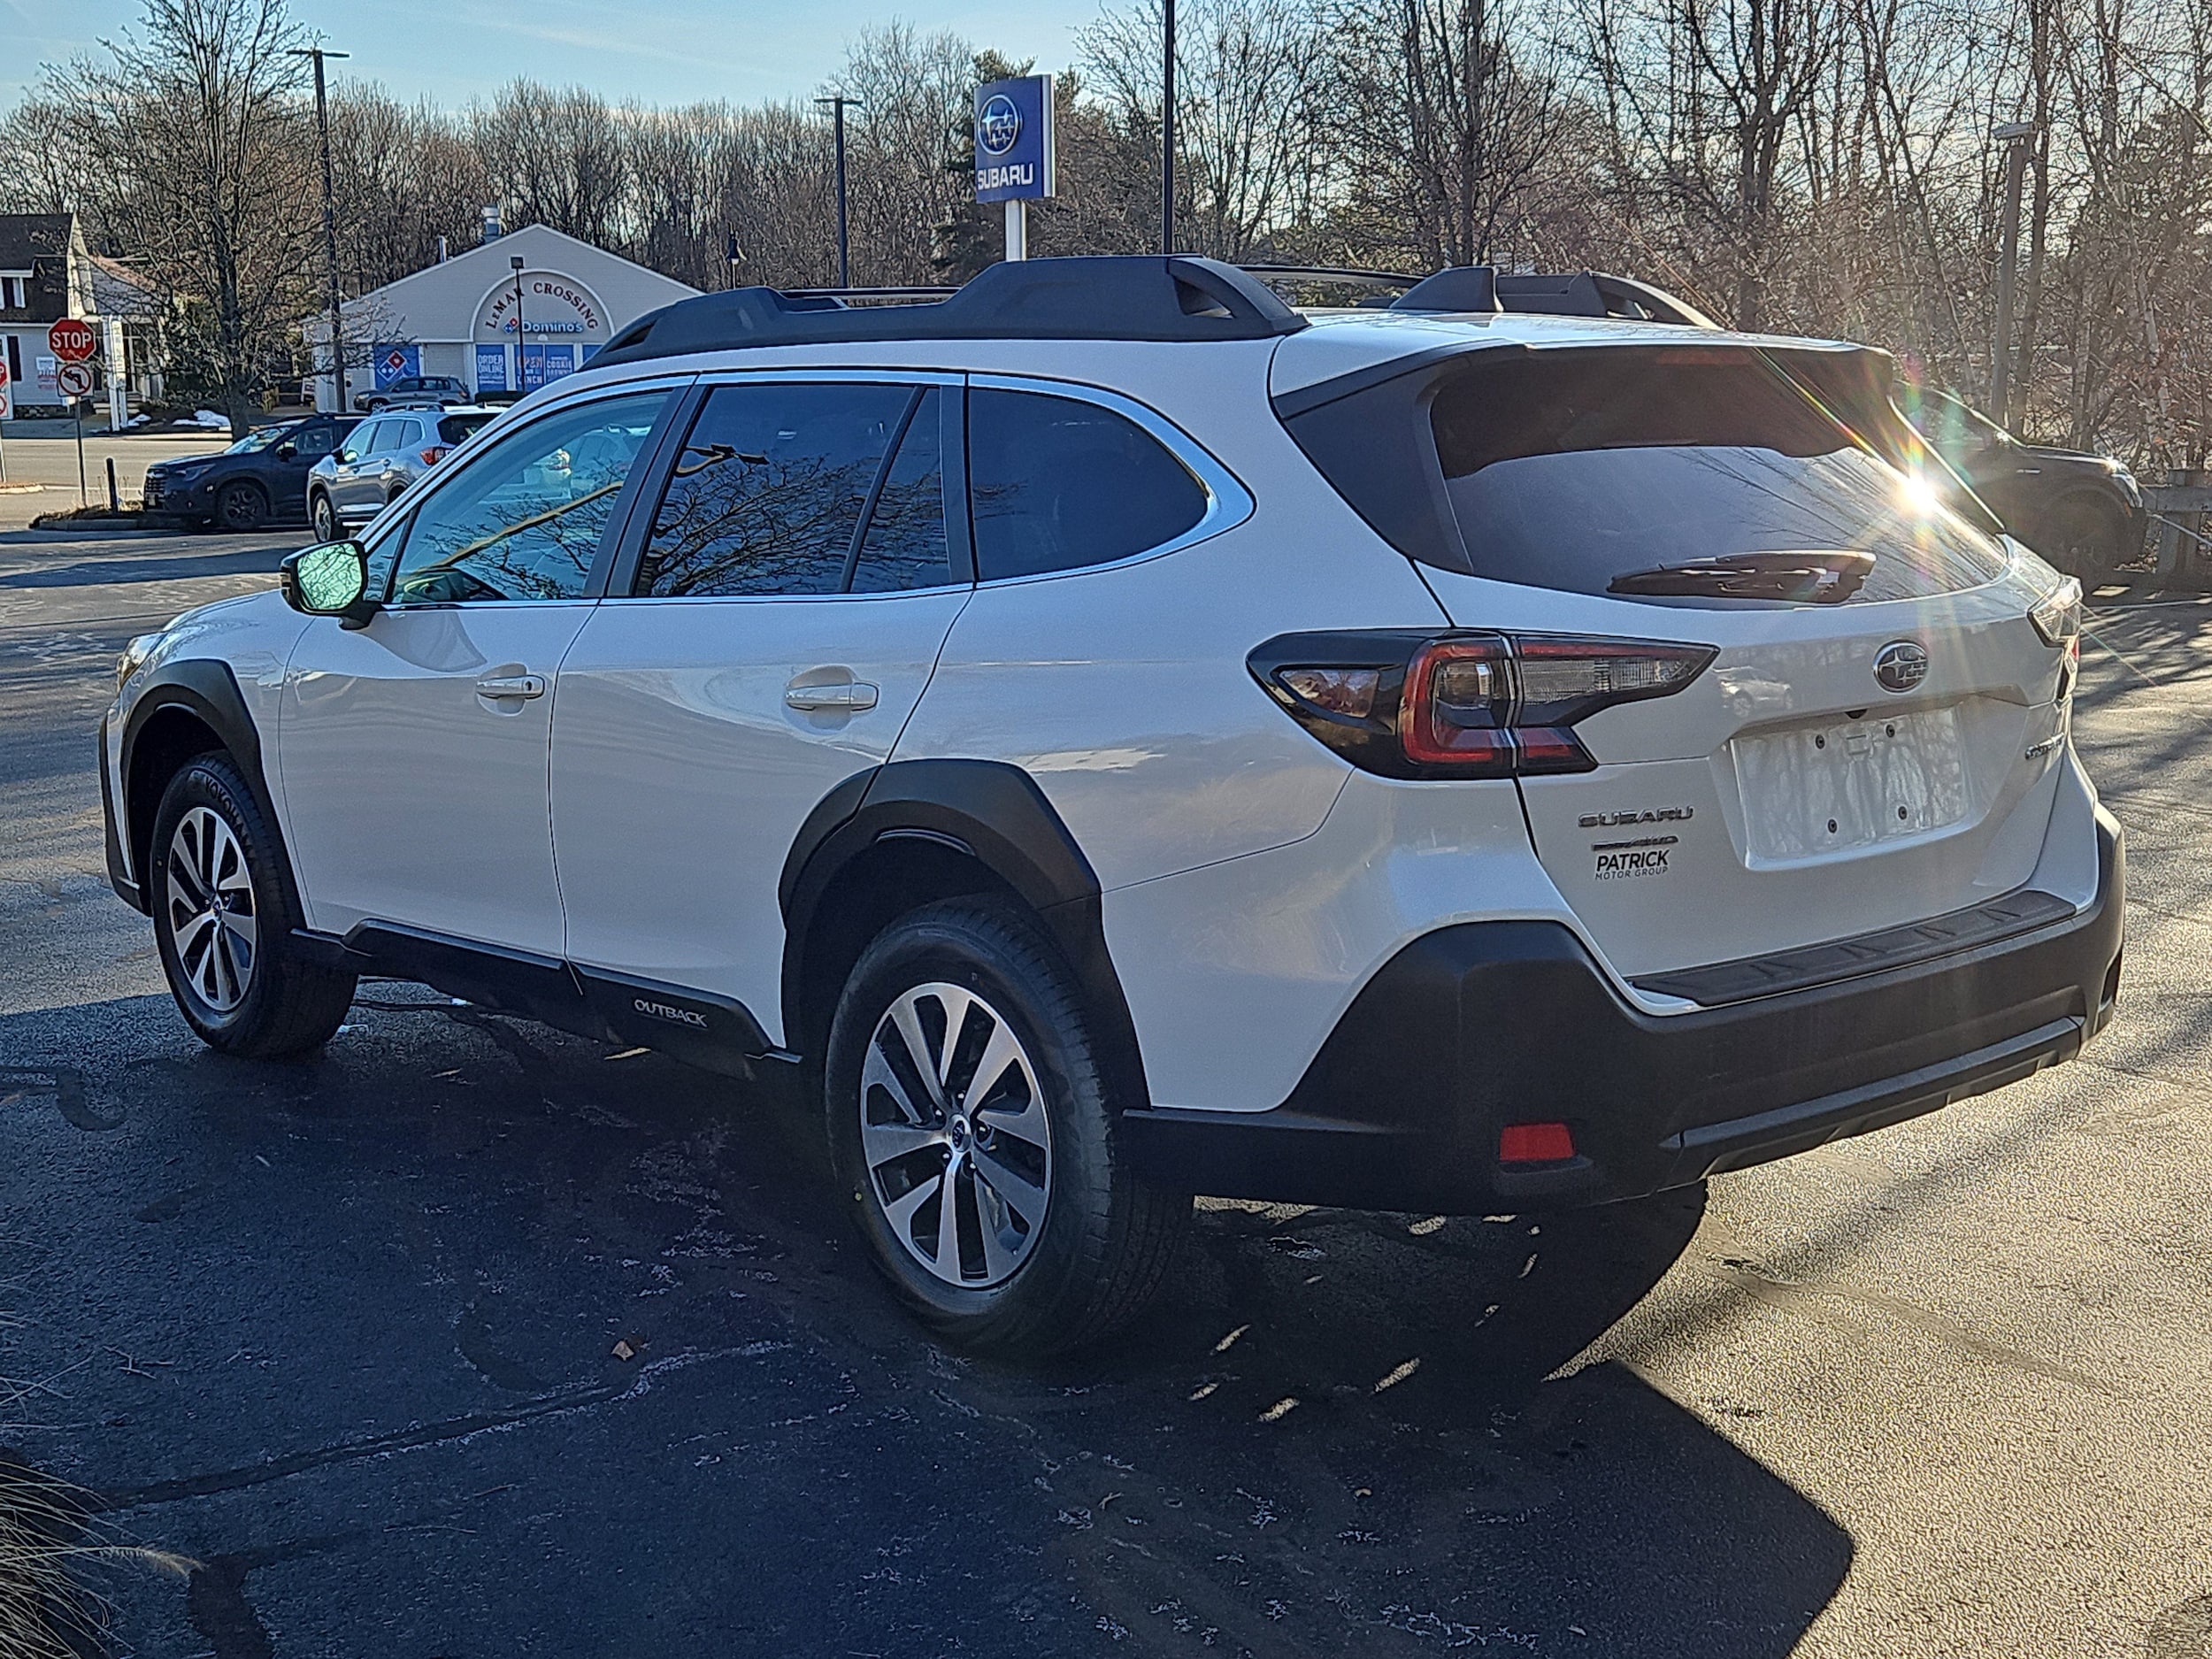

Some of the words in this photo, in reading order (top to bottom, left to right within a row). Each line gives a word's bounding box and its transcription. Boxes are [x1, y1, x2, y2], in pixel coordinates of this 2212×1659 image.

[978, 163, 1033, 190] SUBARU
[533, 281, 599, 330] CROSSING
[523, 320, 583, 333] Domino's
[52, 332, 92, 349] STOP
[477, 354, 504, 365] ORDER
[477, 364, 504, 373] ONLINE
[517, 375, 543, 384] LNCH
[1578, 805, 1694, 828] SUBARU
[1596, 849, 1671, 872] PATRICK
[1594, 870, 1631, 880] MOTOR
[1634, 866, 1668, 877] GROUP
[634, 999, 708, 1027] OUTBACK
